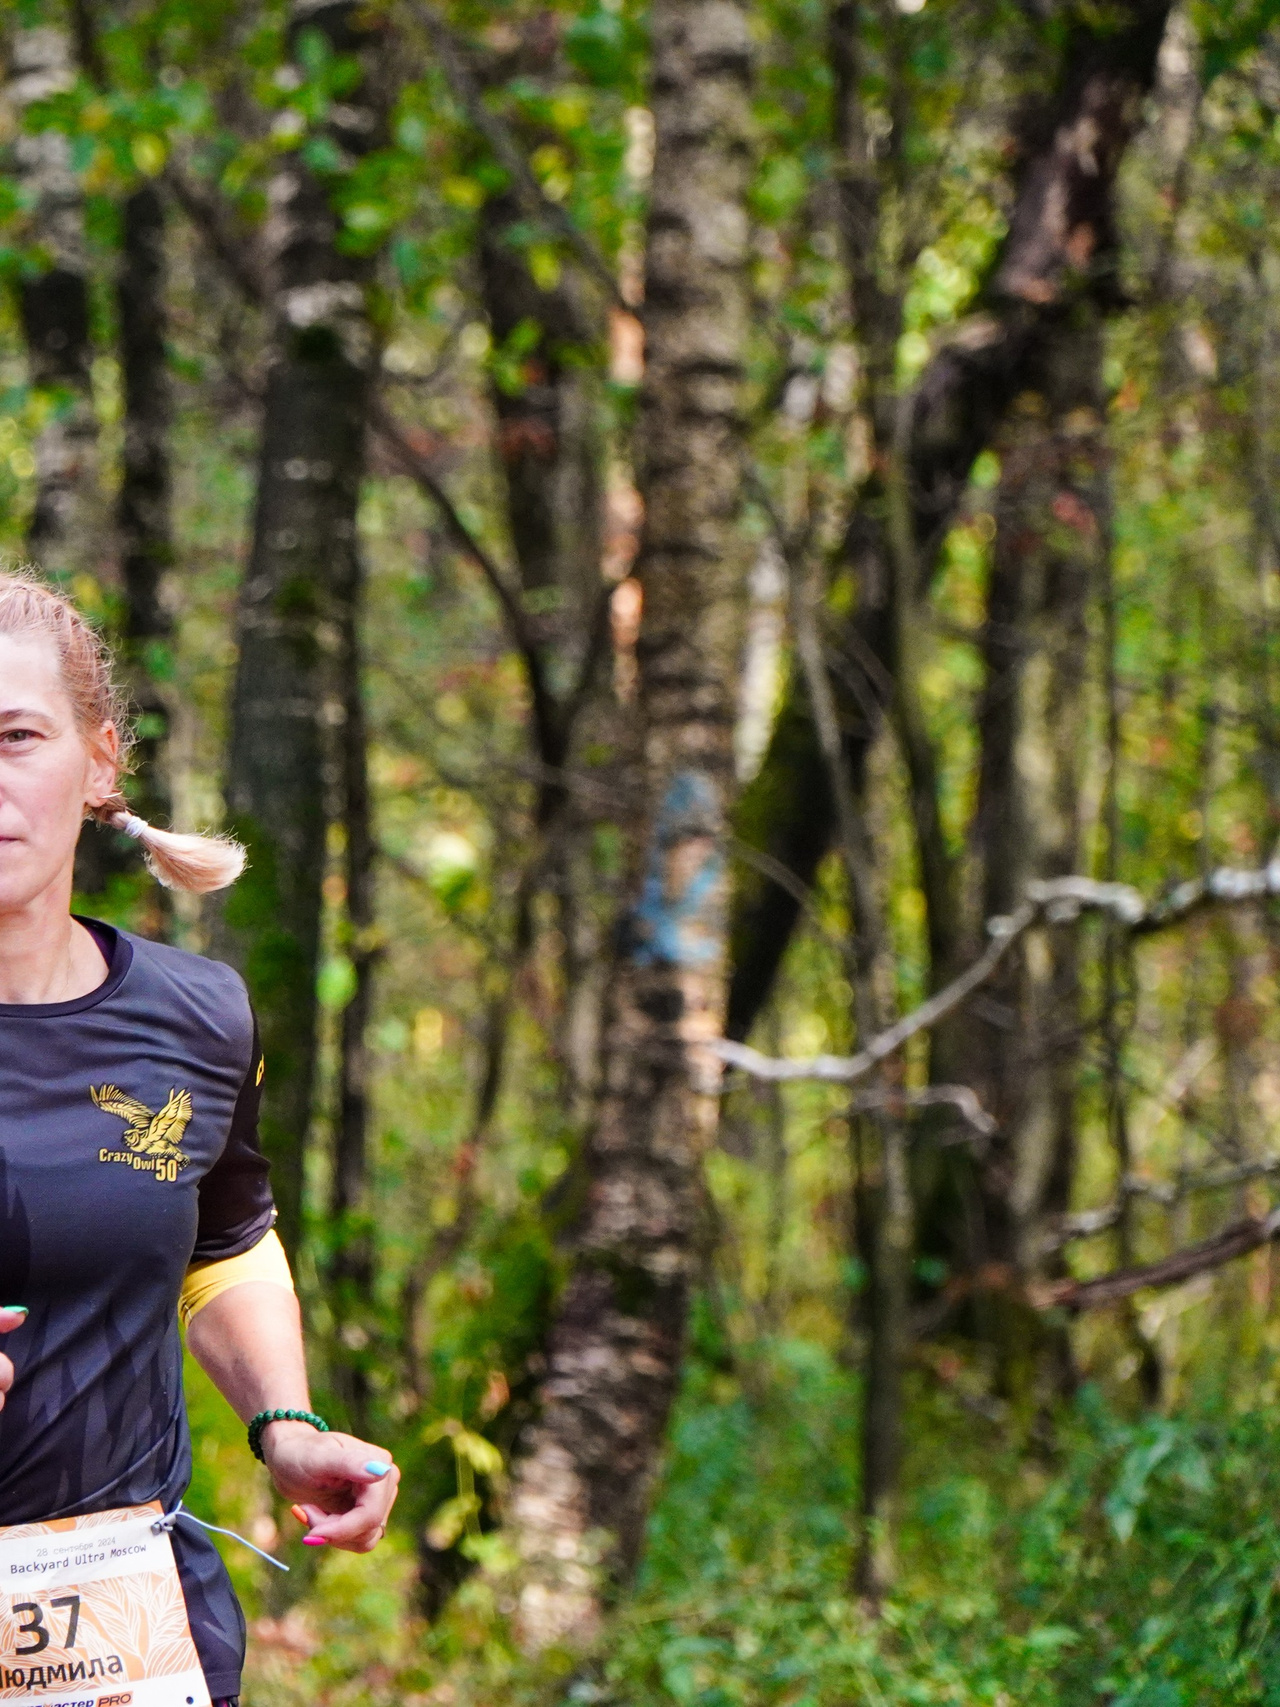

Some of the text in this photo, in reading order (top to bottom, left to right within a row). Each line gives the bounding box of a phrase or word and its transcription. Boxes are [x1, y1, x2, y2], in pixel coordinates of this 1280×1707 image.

[99, 1148, 177, 1182] Crazy Owl 50
[36, 1536, 116, 1557] 28 сентября 2024
[10, 1557, 69, 1574] Backyard
[75, 1551, 105, 1565] Ultra
[12, 1595, 80, 1655] 37
[98, 1693, 132, 1707] PRO
